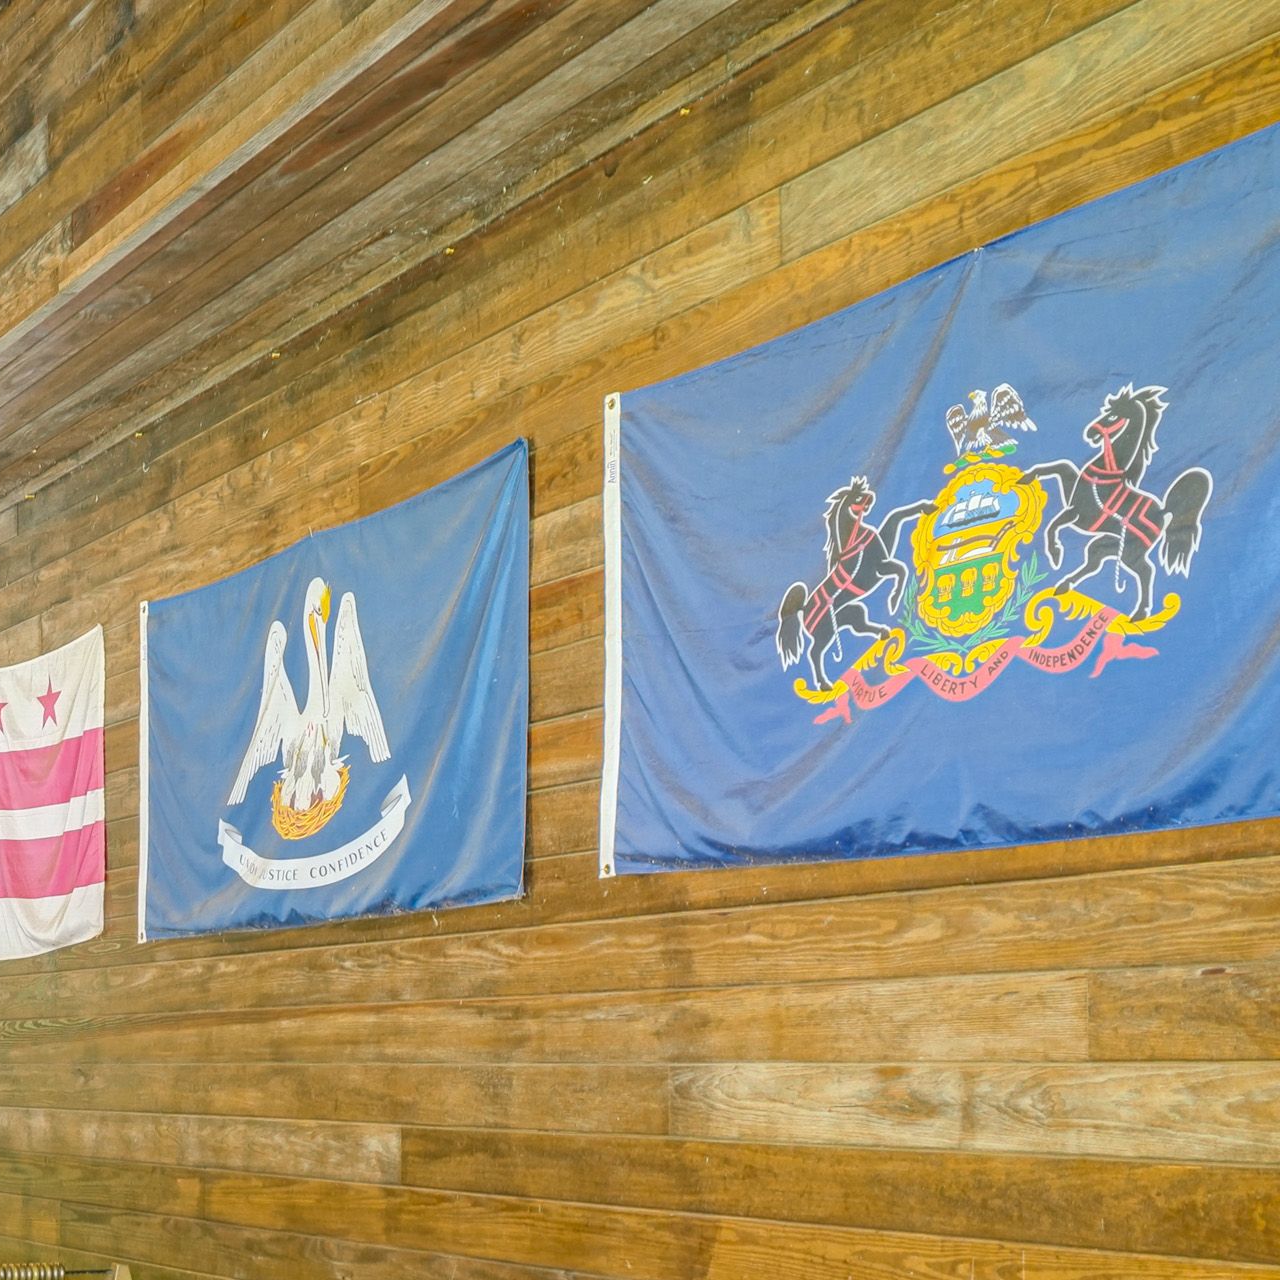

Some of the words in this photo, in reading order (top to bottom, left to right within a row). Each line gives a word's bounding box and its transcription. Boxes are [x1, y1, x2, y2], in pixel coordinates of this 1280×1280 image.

[852, 676, 888, 703] VIRTUE
[920, 664, 979, 695] LIBERTY
[987, 650, 1009, 676] AND
[1028, 612, 1109, 668] INDEPENDENCE
[309, 828, 388, 878] CONFIDENCE
